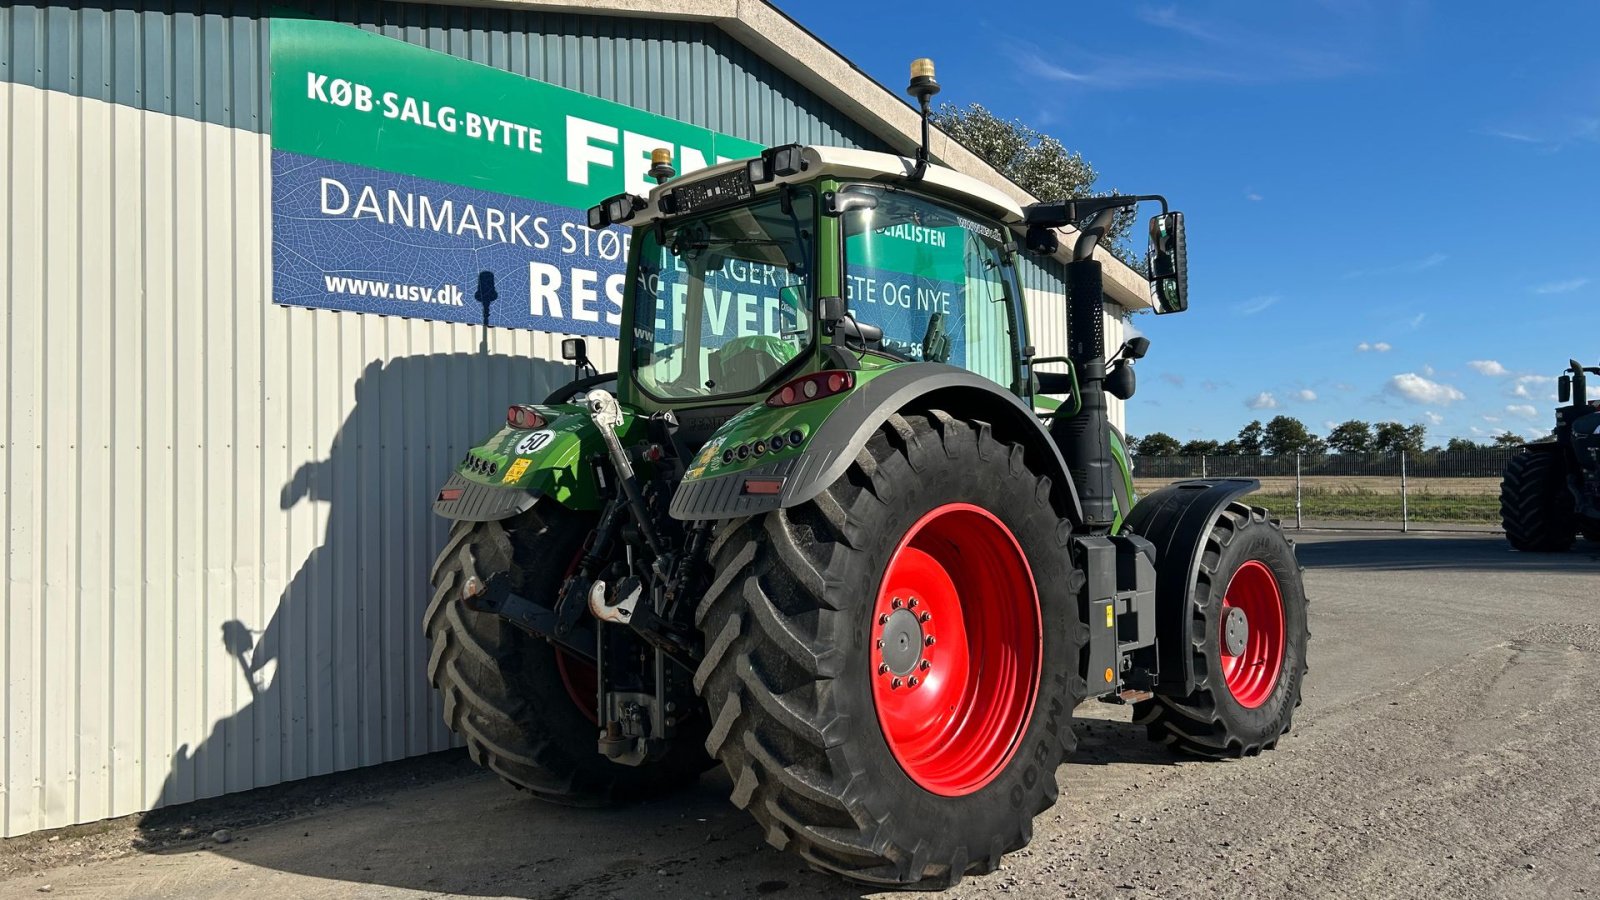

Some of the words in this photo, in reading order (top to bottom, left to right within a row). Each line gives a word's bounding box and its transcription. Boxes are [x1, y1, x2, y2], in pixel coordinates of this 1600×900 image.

[320, 177, 549, 249] DANMARKS
[883, 282, 911, 309] OG
[917, 288, 950, 314] NYE
[324, 274, 463, 307] www.usv.dk
[520, 433, 550, 451] 50
